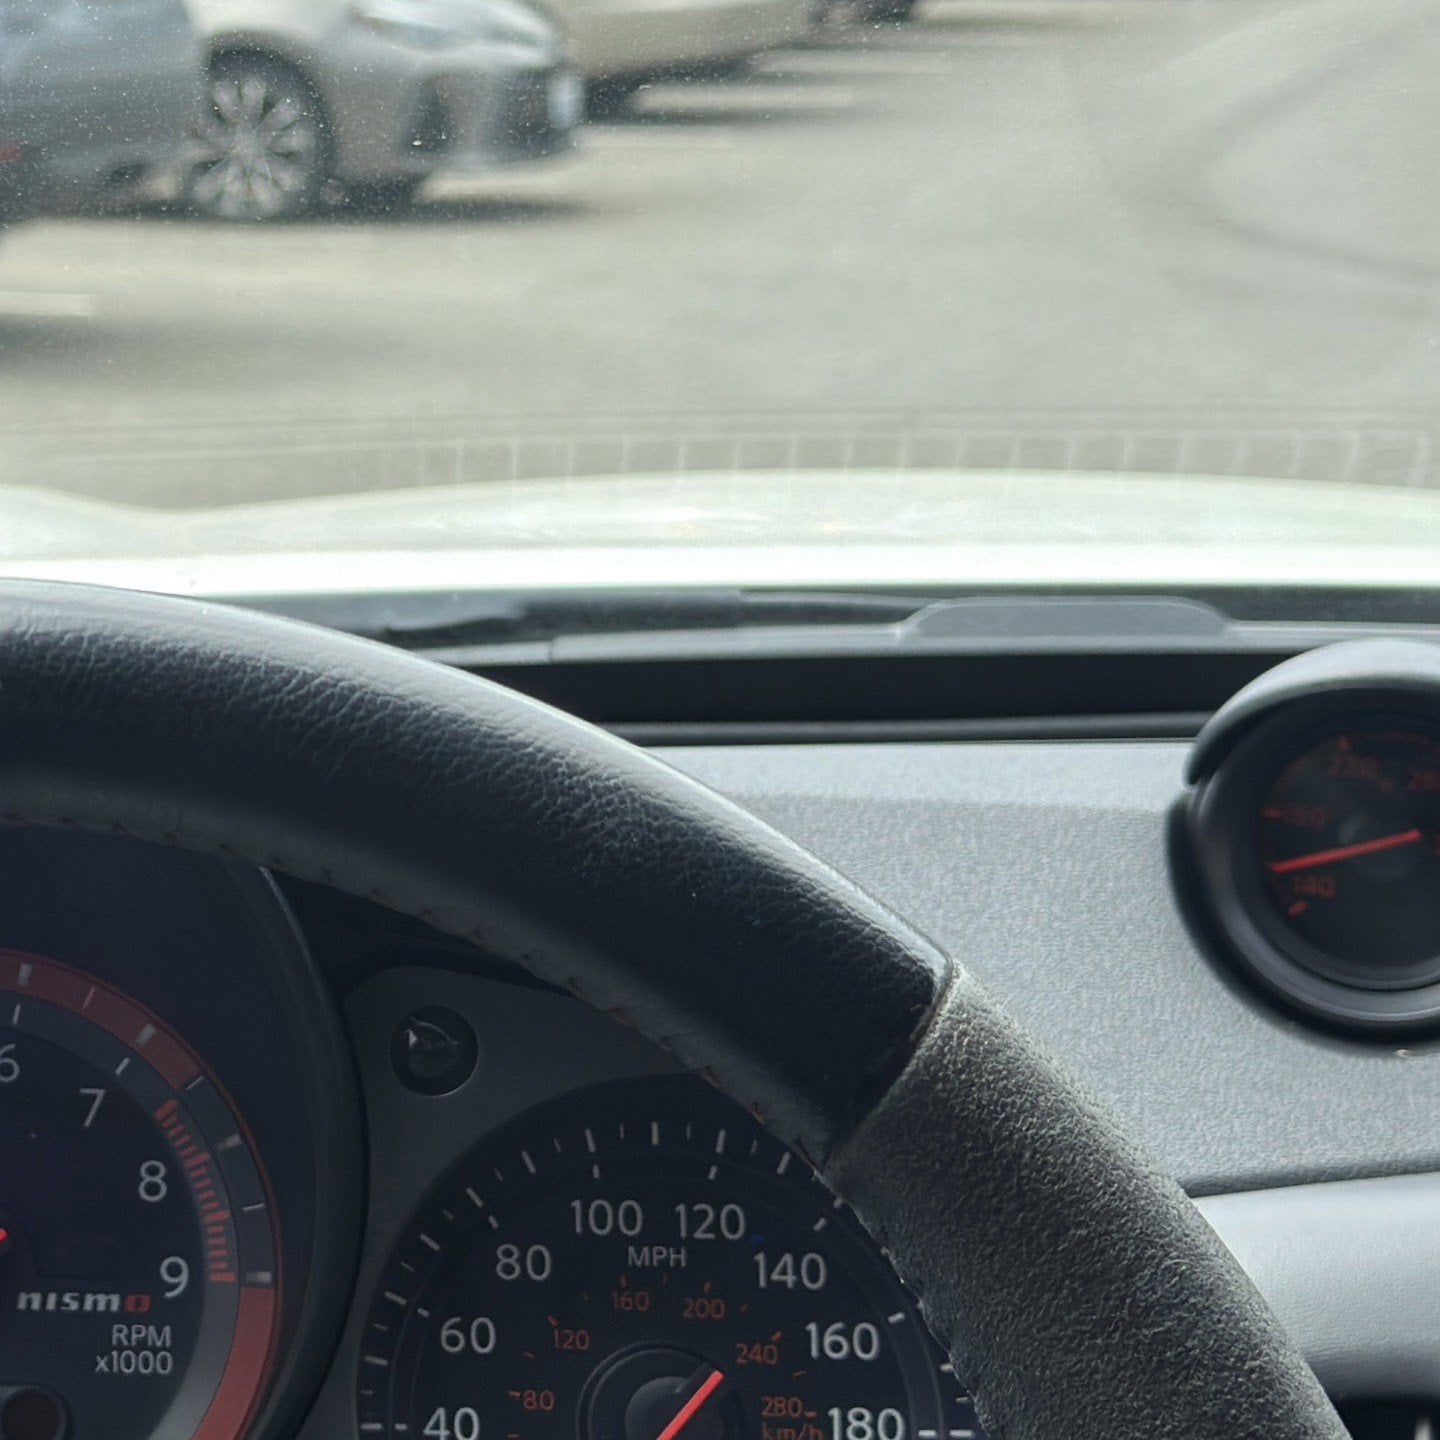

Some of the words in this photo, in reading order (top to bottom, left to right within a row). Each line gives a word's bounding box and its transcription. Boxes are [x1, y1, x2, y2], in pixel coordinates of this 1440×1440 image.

[79, 1088, 107, 1127] 7
[139, 1161, 168, 1201] 8
[571, 1199, 643, 1236] 100
[674, 1203, 745, 1241] 120
[496, 1244, 552, 1282] 80
[627, 1245, 687, 1268] MPH
[753, 1252, 825, 1291] 140
[160, 1256, 189, 1297] 9
[17, 1292, 152, 1312] nismo
[613, 1291, 650, 1312] 160
[682, 1298, 726, 1320] 200
[111, 1324, 172, 1347] RPM
[439, 1317, 496, 1355] 60
[553, 1329, 590, 1351] 120
[807, 1321, 878, 1361] 160
[736, 1343, 778, 1365] 240
[523, 1389, 554, 1411] 80
[761, 1397, 803, 1418] 280
